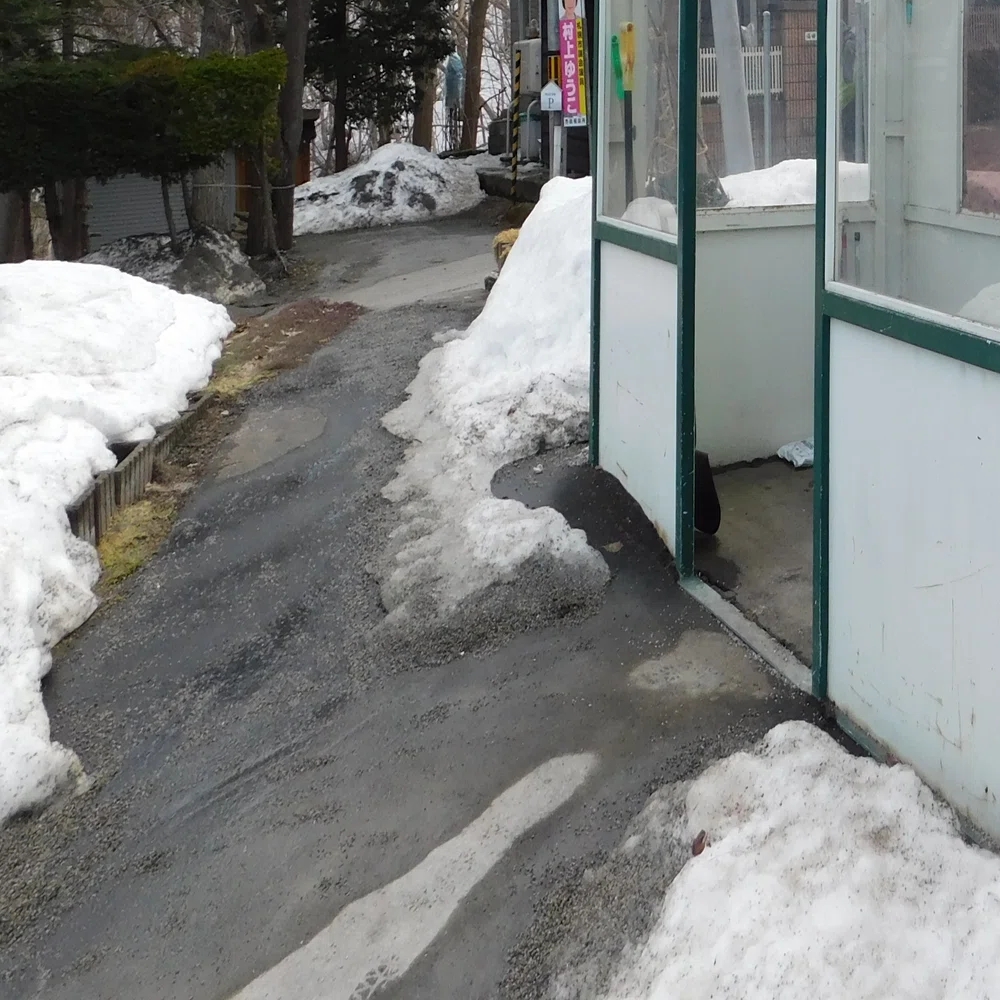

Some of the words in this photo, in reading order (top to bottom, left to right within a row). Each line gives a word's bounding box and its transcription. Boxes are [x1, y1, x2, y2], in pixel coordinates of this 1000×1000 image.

[562, 21, 578, 114] 村上ゆうこ
